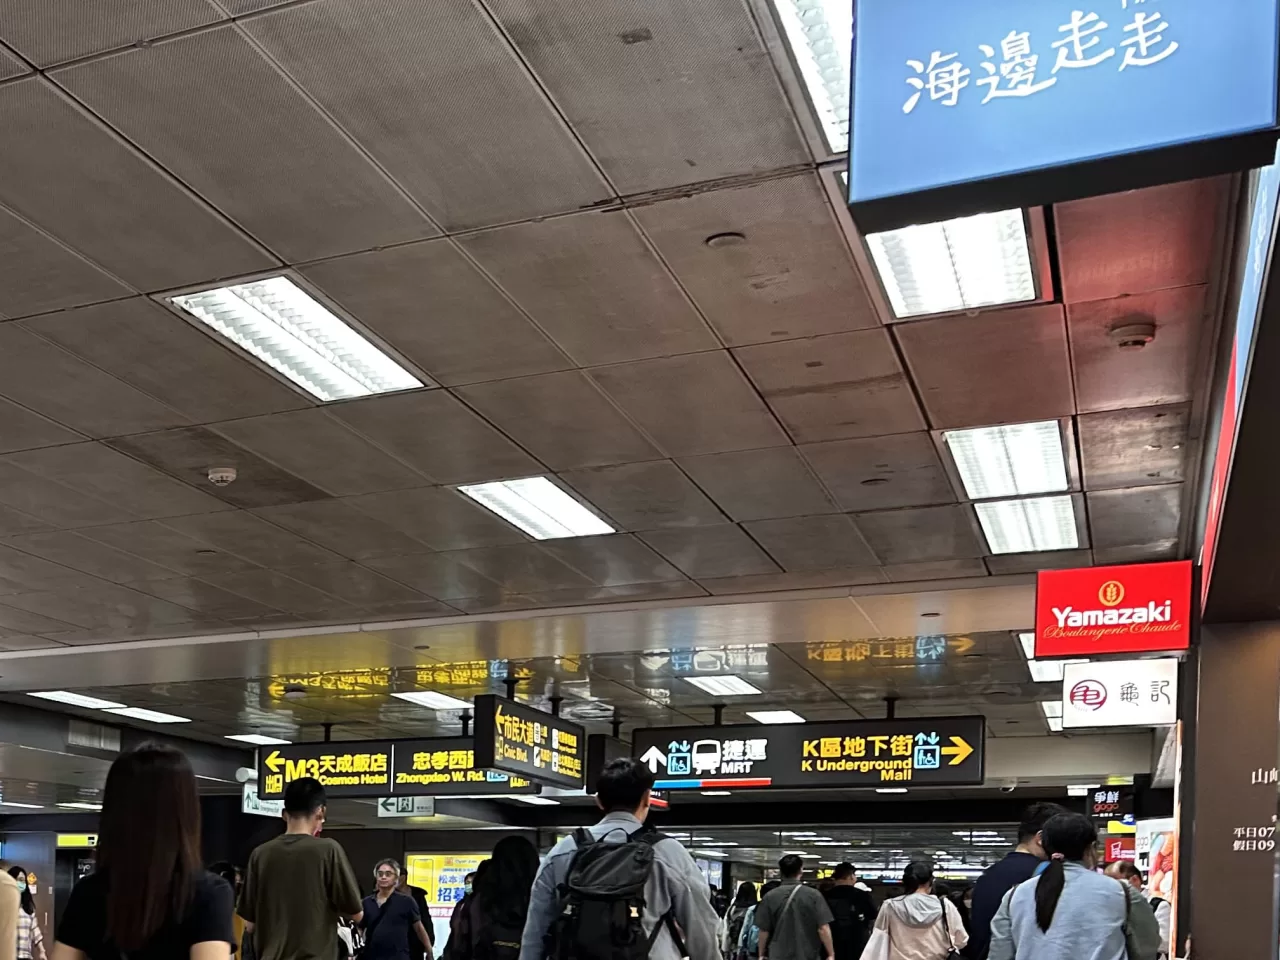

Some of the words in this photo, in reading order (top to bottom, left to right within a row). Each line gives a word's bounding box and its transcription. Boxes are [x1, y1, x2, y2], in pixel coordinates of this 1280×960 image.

[902, 11, 1178, 115] 海邊走走
[1051, 600, 1171, 627] Yamazaki
[1043, 624, 1128, 641] Boulangerie
[1130, 620, 1181, 634] Chaude
[1120, 680, 1171, 706] 龜記
[504, 714, 535, 747] 市民大道
[803, 735, 914, 758] K區地下街
[285, 759, 320, 783] M3
[319, 753, 388, 773] 天成飯店
[721, 761, 754, 774] MRT
[801, 760, 813, 771] K
[816, 757, 912, 772] Underground
[265, 774, 283, 793] 出口
[319, 775, 359, 785] Cosmos
[360, 774, 387, 784] Hotel
[451, 771, 465, 782] W.
[467, 771, 485, 782] Rd.
[881, 769, 912, 781] Mall
